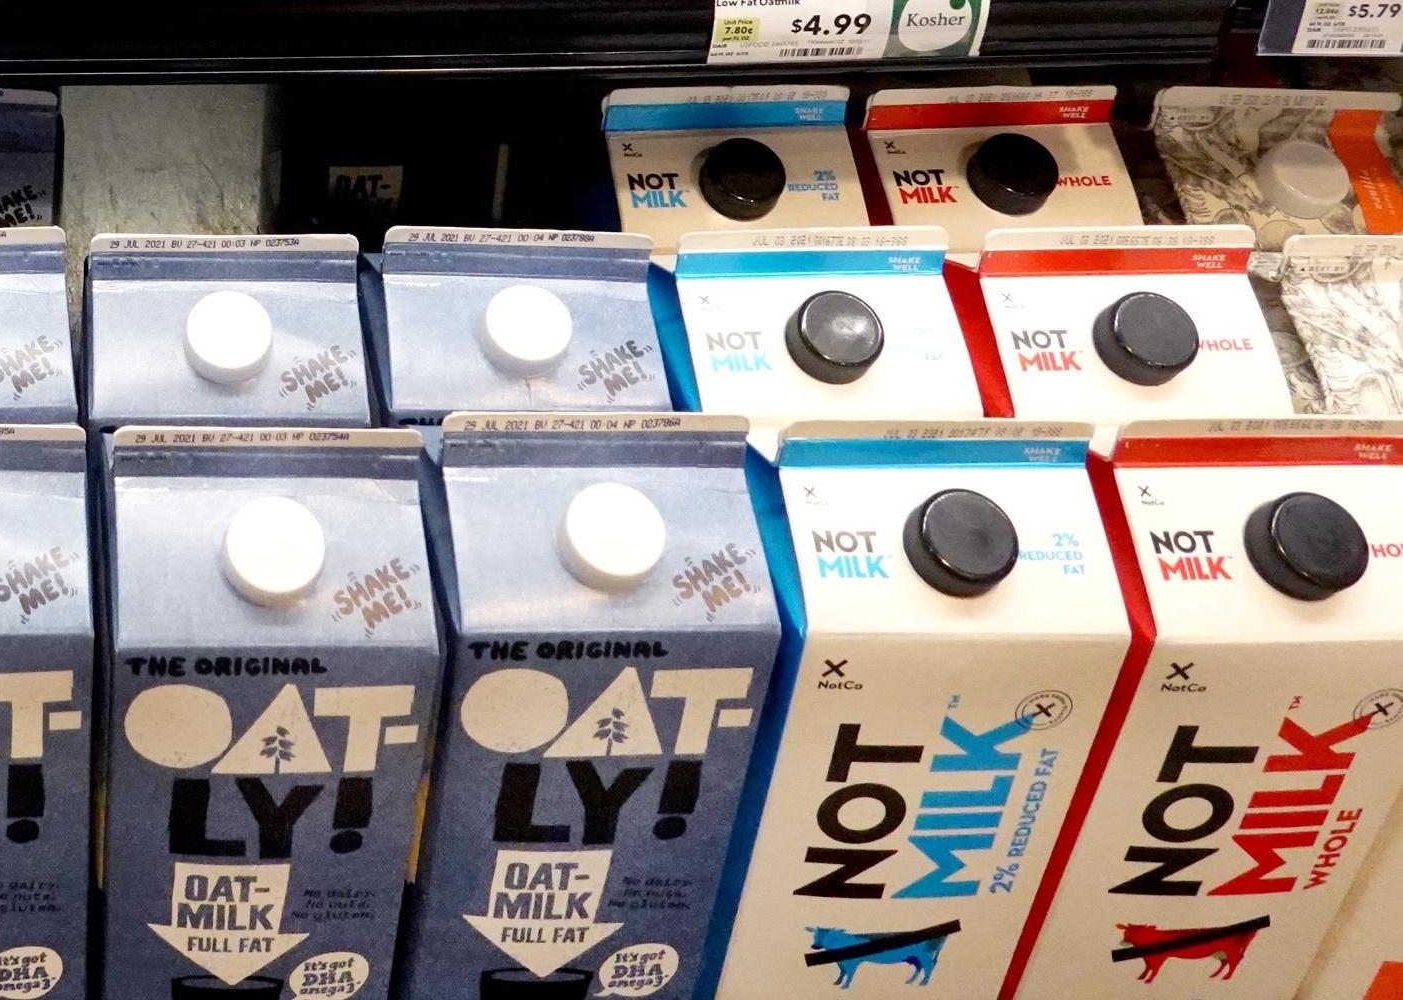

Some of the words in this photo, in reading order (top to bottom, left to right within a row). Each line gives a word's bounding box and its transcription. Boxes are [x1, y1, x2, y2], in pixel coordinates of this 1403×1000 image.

[716, 0, 738, 7] Low
[1348, 3, 1401, 18] $5.79
[791, 13, 872, 36] $4.99
[906, 12, 965, 27] Kosher
[724, 26, 754, 35] 7.80¢
[627, 173, 680, 190] NOT
[813, 170, 836, 182] 2%
[788, 182, 838, 192] REDUCED
[821, 192, 840, 201] FAT
[630, 190, 688, 209] MILK
[109, 240, 120, 249] 29
[146, 240, 166, 248] 2021
[186, 240, 216, 248] 27-421
[705, 331, 762, 351] NOT
[1011, 330, 1068, 350] NOT
[710, 353, 773, 372] MILK
[1018, 351, 1082, 371] MILK
[812, 531, 876, 553] NOT
[1052, 534, 1079, 547] 2%
[1150, 531, 1214, 554] NOT
[1019, 551, 1083, 561] REDUCED
[816, 556, 889, 579] MILK
[1064, 565, 1085, 575] FAT
[1158, 557, 1232, 581] MILK
[19, 573, 69, 615] ME!
[467, 640, 528, 661] THE
[536, 640, 669, 660] ORIGINAL
[818, 681, 863, 691] NotCo
[1161, 684, 1207, 692] NotCo
[460, 666, 753, 758] OAT-
[493, 760, 703, 845] LY!
[793, 723, 924, 899] NOT
[890, 714, 1034, 899] MILK
[1108, 725, 1259, 896] NOT
[1206, 714, 1373, 896] MILK
[988, 863, 1020, 894] 2%
[1007, 785, 1048, 858] REDUCED
[1034, 749, 1059, 785] FAT
[1303, 808, 1363, 890] WHOLE
